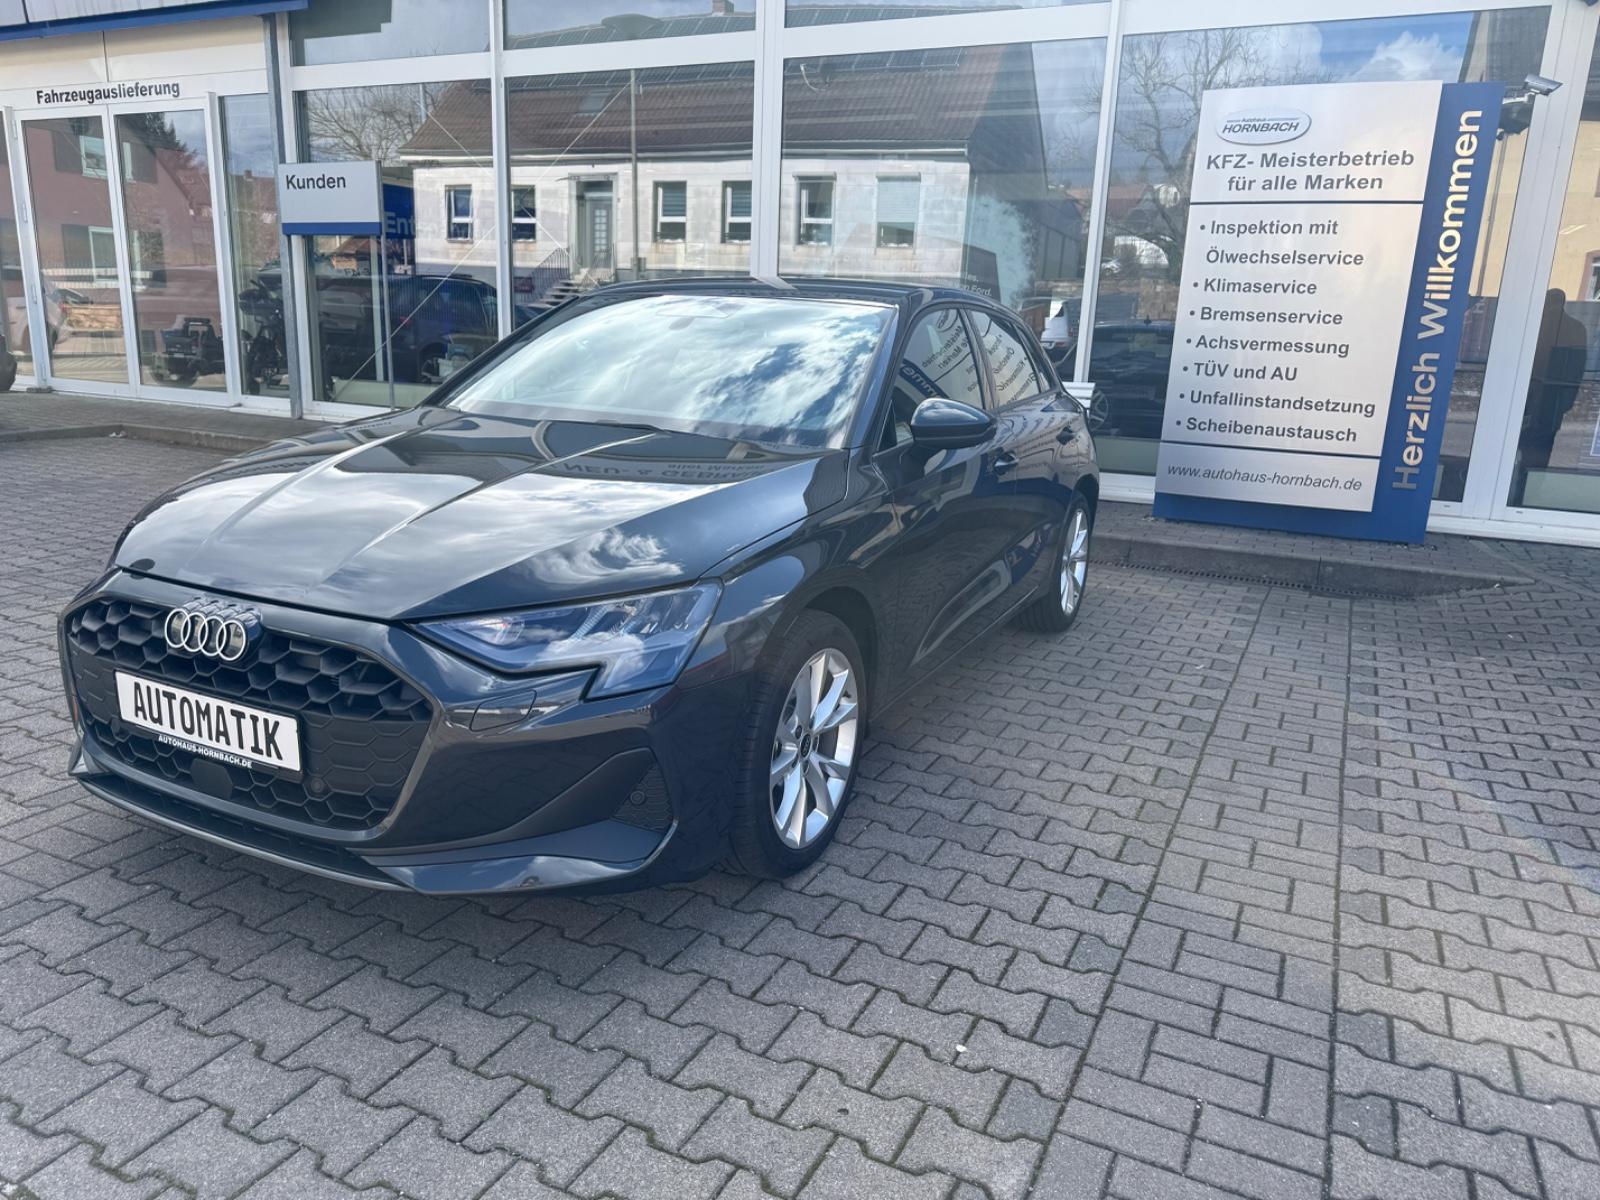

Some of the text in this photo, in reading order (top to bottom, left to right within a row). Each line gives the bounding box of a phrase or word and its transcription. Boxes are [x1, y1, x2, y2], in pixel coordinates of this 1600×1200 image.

[37, 80, 180, 104] Fahrzeugauslieferung
[1222, 122, 1299, 133] HORNBACH
[1206, 151, 1414, 170] KFZ- Meisterbetrieb
[286, 174, 346, 189] Kunden
[1227, 174, 1383, 191] für alle Marken
[1210, 220, 1338, 238] Inspektion mit
[1206, 247, 1364, 266] Ölwechselservice
[1203, 279, 1317, 295] Klimaservice
[1392, 110, 1482, 490] Herzlich Willkommen
[1200, 307, 1343, 325] Bremsenservice
[1195, 335, 1350, 358] Achsvermessung
[1194, 360, 1298, 381] TÜV und AU
[1190, 390, 1376, 418] Unfallinstandsetzung
[1186, 417, 1357, 443] Scheibenaustausch
[1167, 463, 1362, 492] www.autohaus-hornbach.de
[133, 682, 283, 760] AUTOMATIK
[158, 735, 252, 768] AUTOHAUS-HORNBACH.DE
